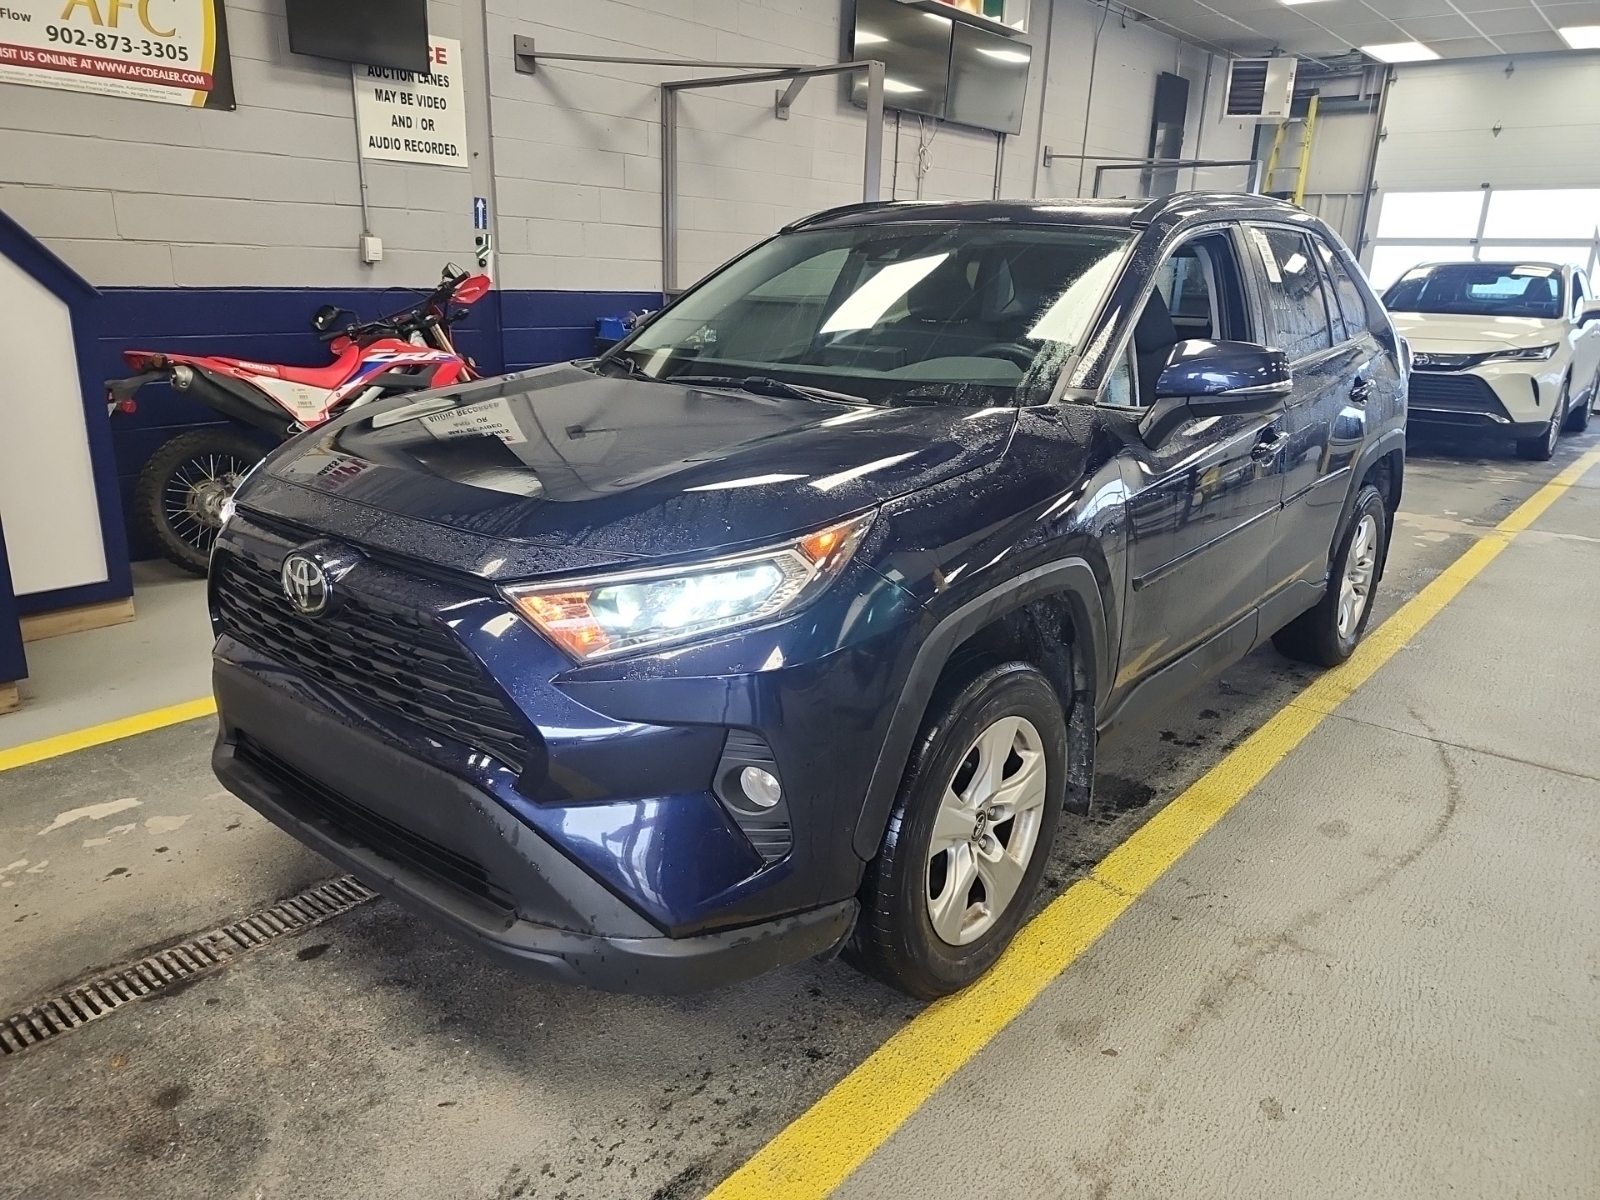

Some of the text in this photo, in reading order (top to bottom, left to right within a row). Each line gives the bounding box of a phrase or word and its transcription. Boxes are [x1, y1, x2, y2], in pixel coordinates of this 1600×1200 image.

[0, 8, 31, 22] Flow
[46, 25, 188, 61] 902-873-3305
[20, 50, 35, 62] US
[37, 52, 77, 68] ONLINE
[80, 59, 92, 69] AT
[94, 61, 205, 85] WWW.AFCDEALER.COM
[418, 73, 450, 88] LANES
[374, 88, 447, 110] MAY BE VIDEO
[391, 114, 413, 129] AND
[421, 118, 435, 132] OR
[368, 135, 460, 157] AUDIO RECORDED.
[239, 361, 278, 373] HONDA
